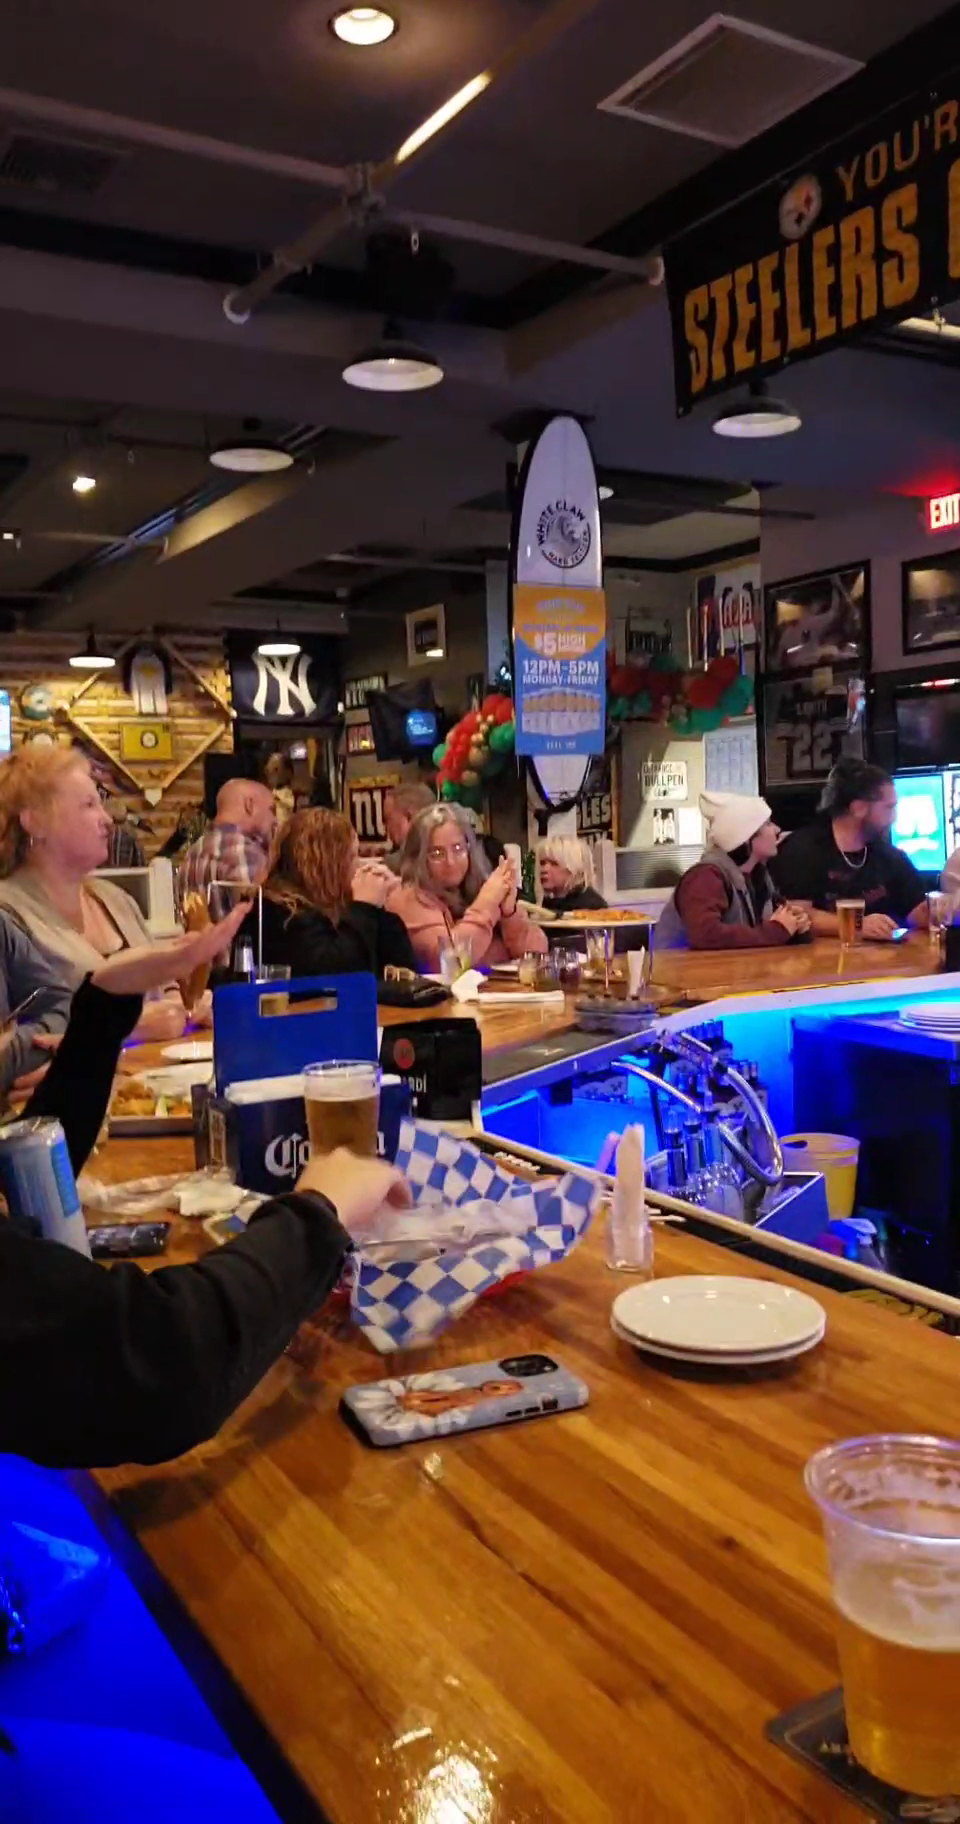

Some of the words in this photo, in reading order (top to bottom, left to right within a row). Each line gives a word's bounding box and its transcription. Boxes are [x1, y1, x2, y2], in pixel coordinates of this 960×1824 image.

[684, 182, 921, 394] STEELERS
[536, 504, 554, 546] WHITE
[555, 498, 586, 521] CLAW
[522, 658, 600, 676] 12PM-5PM
[790, 721, 834, 771] 22
[643, 774, 685, 788] BULLPEN
